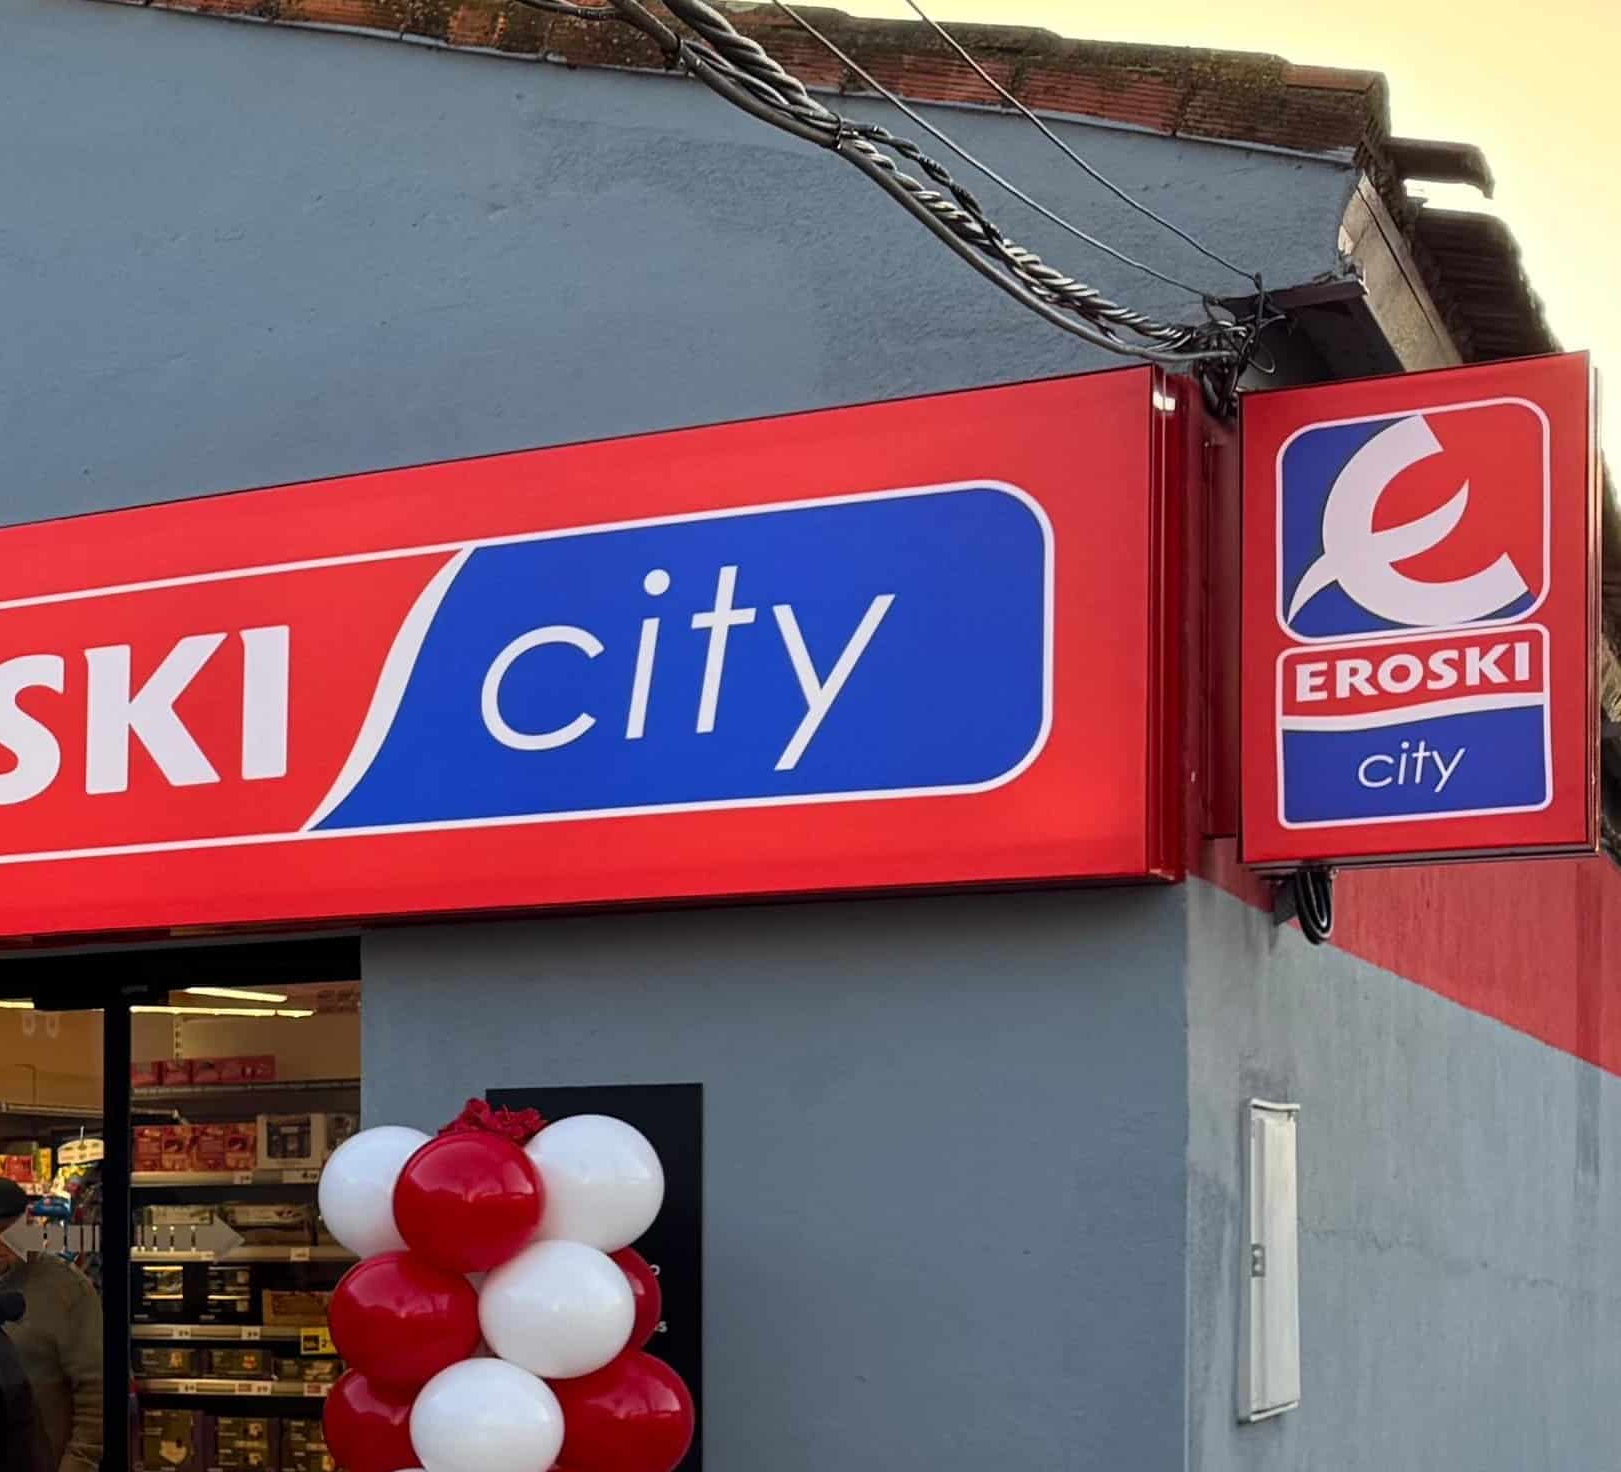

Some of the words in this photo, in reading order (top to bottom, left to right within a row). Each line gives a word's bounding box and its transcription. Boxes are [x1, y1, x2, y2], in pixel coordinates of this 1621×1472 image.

[480, 565, 897, 772] city
[1294, 641, 1531, 702] EROSKI
[1358, 740, 1466, 794] city
